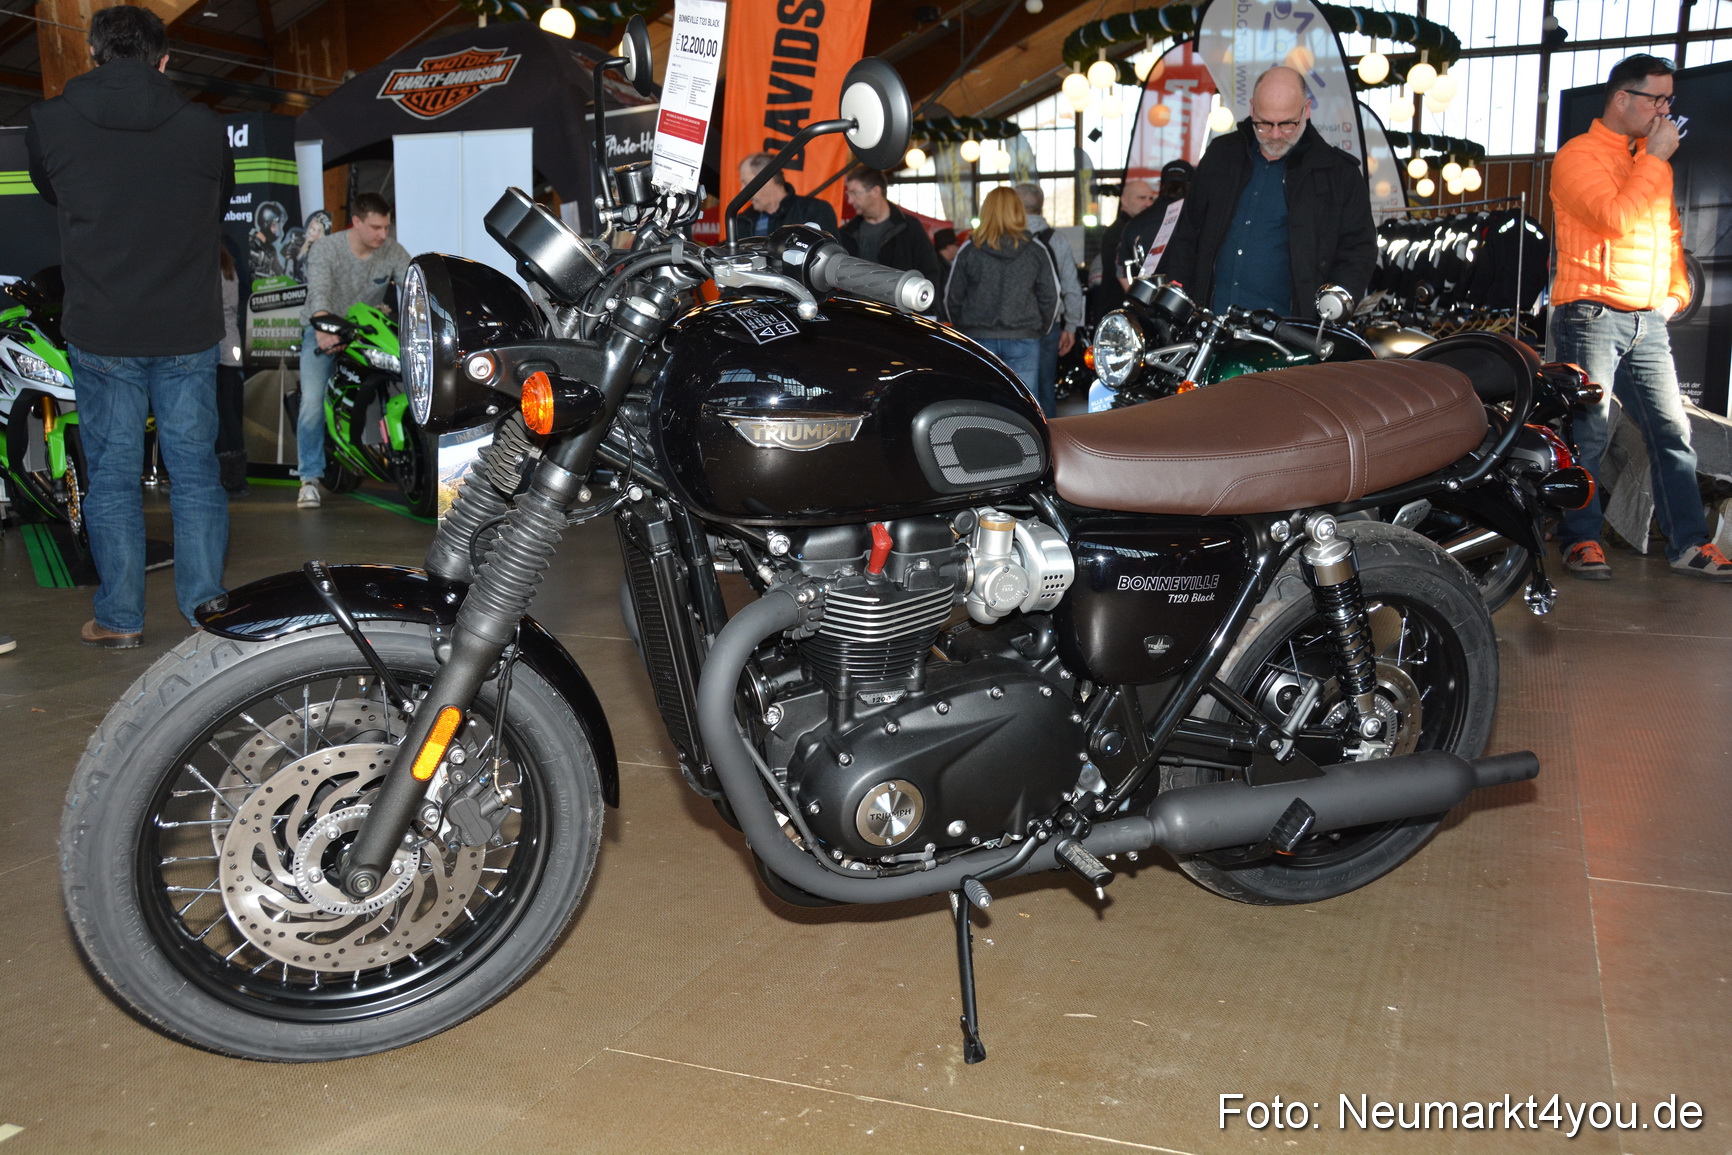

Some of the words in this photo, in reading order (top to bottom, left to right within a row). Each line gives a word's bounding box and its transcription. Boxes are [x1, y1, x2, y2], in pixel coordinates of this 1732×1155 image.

[678, 14, 699, 25] BONNEVILLE
[708, 18, 720, 28] BLACK
[430, 53, 491, 71] MOTOR
[392, 63, 507, 91] HARLEY-DAVIDSON
[410, 85, 468, 111] CYCLES
[750, 423, 852, 446] TRIUMPH
[1117, 574, 1220, 591] BONNEVILLE
[1168, 594, 1189, 604] T120
[1190, 592, 1216, 603] Black
[869, 807, 912, 822] TRIUMPH
